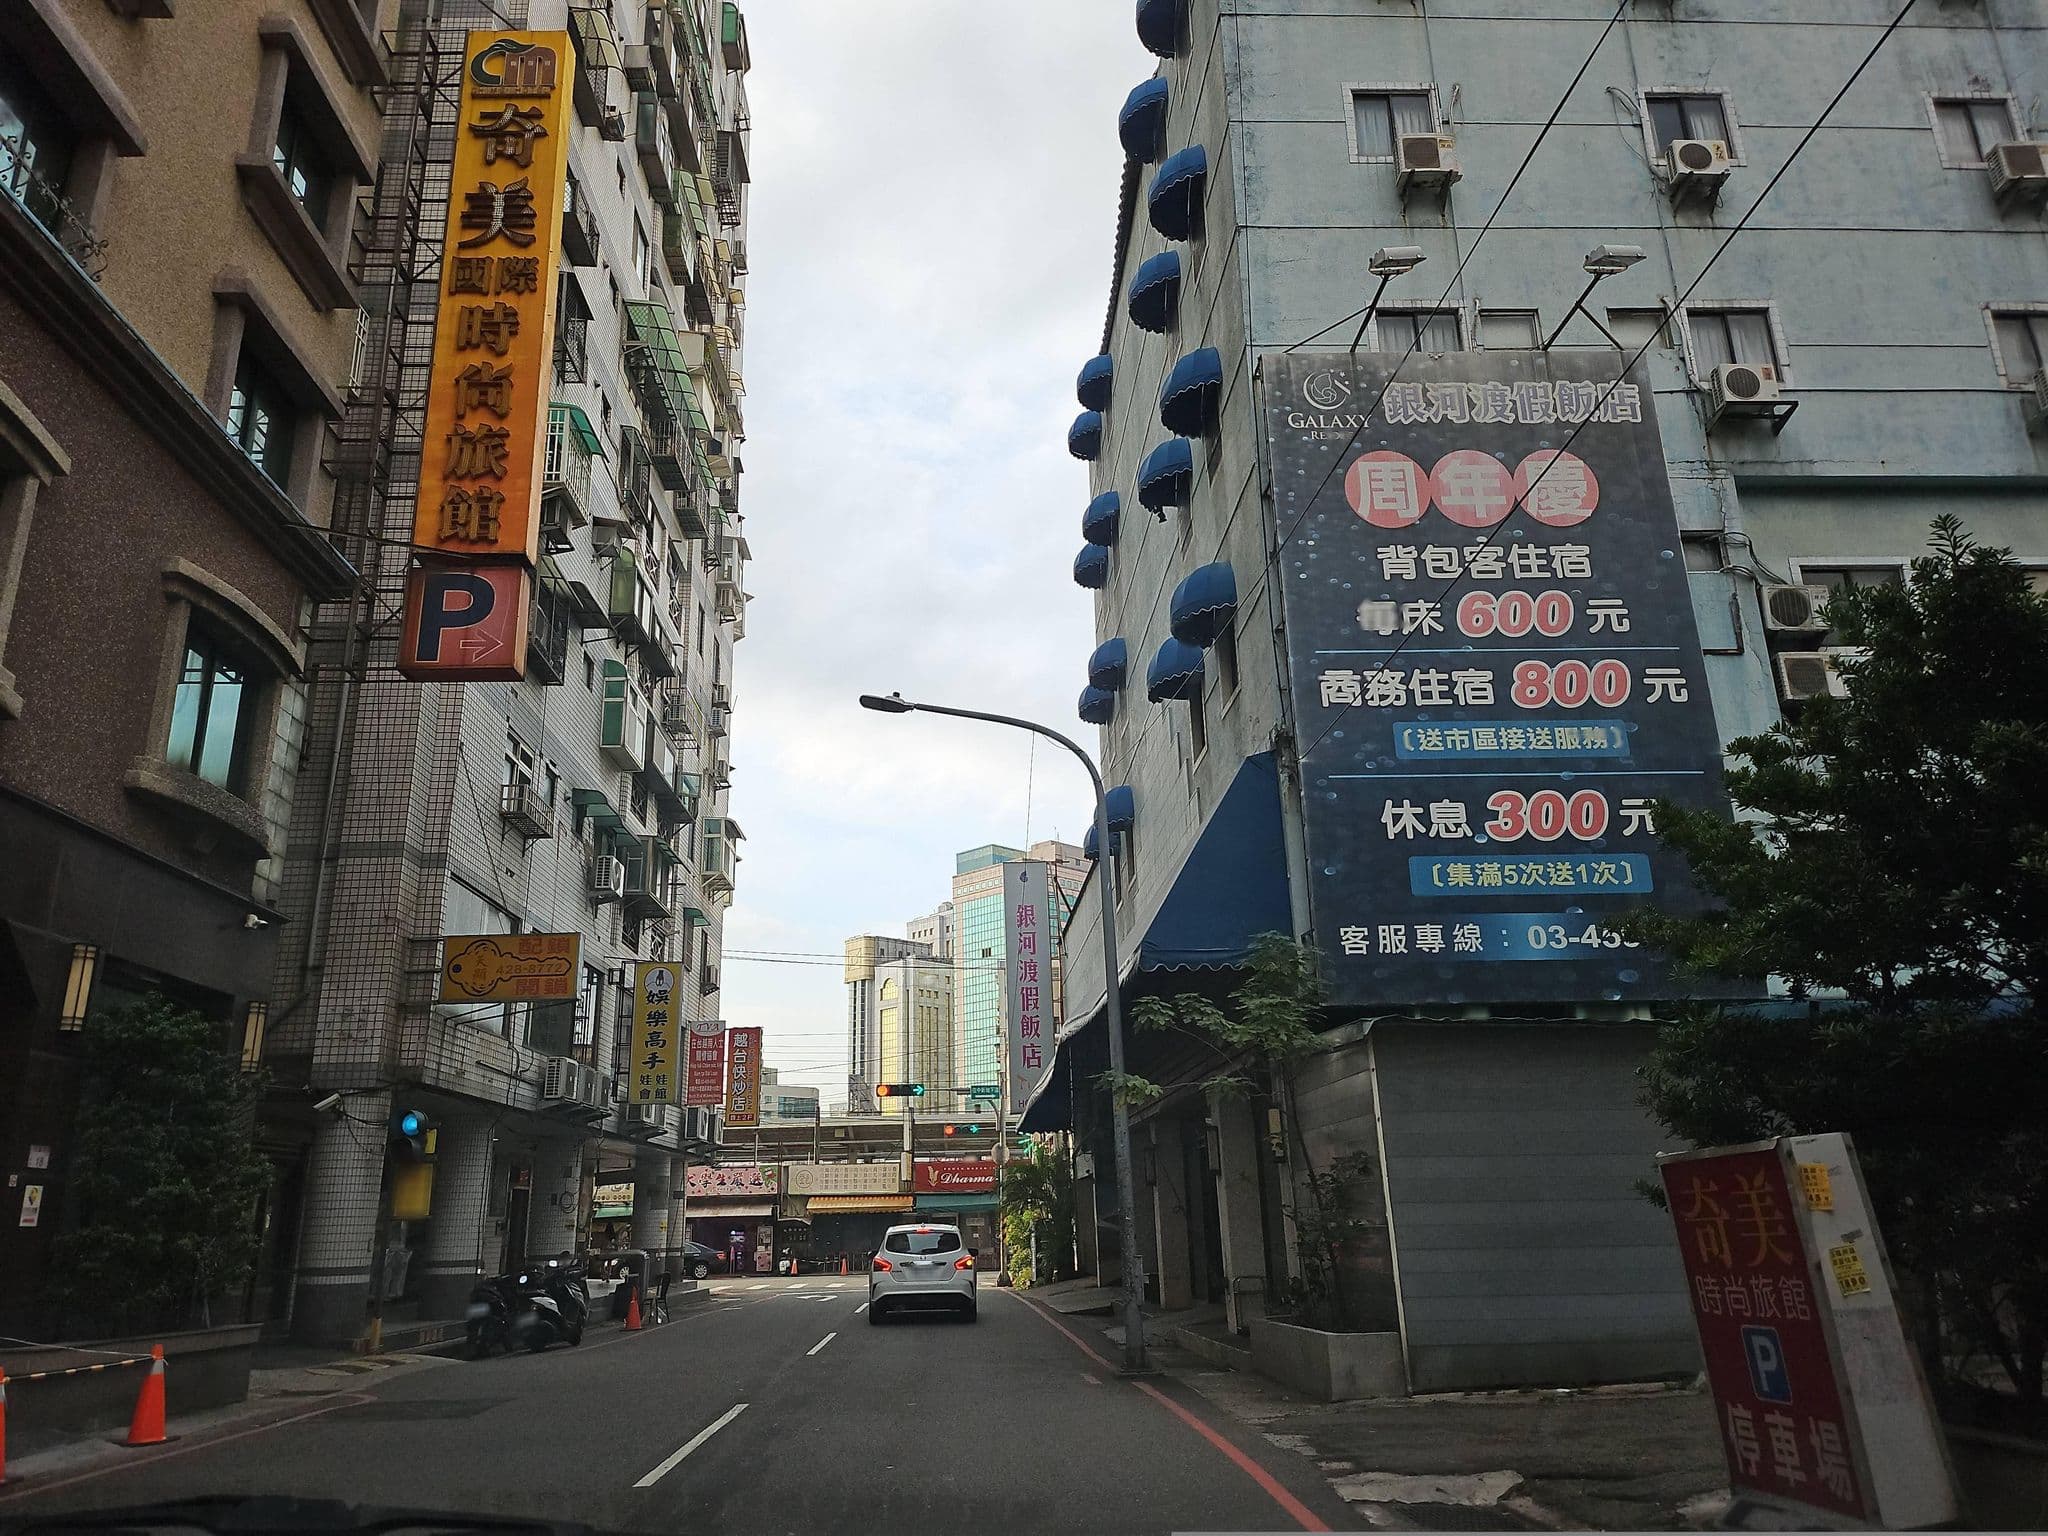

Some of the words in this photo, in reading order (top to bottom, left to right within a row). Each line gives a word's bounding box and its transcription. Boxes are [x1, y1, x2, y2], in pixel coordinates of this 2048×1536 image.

[1288, 412, 1371, 429] GALAXY
[1382, 380, 1642, 425] 銀河渡假飯店
[1357, 459, 1594, 519] 周年慶
[1377, 544, 1593, 581] 背包客住宿
[415, 573, 496, 662] P
[1457, 590, 1574, 637] 600
[1586, 599, 1631, 634] 元
[1319, 668, 1495, 708] 商務住宿
[1511, 659, 1631, 708] 800
[1644, 667, 1688, 703] 元
[1381, 799, 1473, 840] 休息
[1485, 790, 1608, 841] 300
[1618, 799, 1657, 837] 元
[1015, 903, 1042, 1069] 銀河渡假飯店
[641, 989, 670, 1070] 娛樂高手
[731, 1032, 749, 1112] 越台快炒店
[940, 1172, 994, 1184] Dharma
[1682, 1169, 1794, 1268] 奇美
[1695, 1273, 1812, 1321] 時尚旅館
[1752, 1334, 1778, 1393] P
[1725, 1401, 1858, 1501] 停車場
